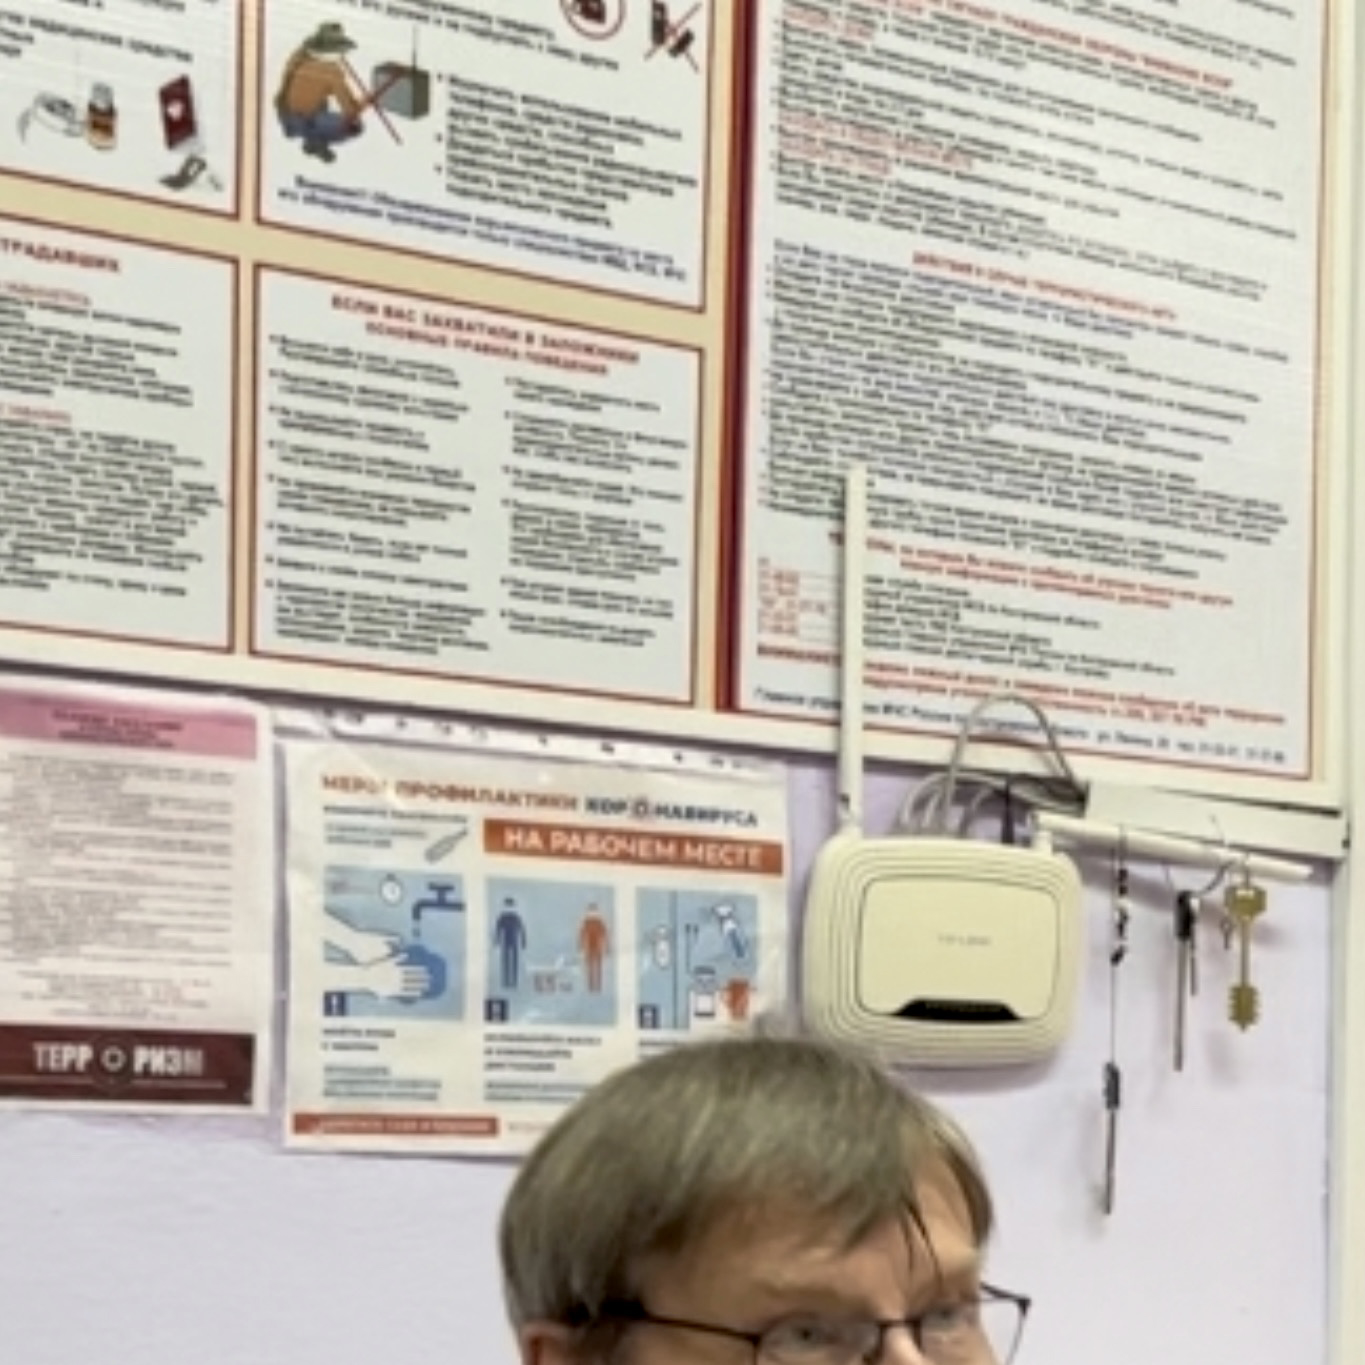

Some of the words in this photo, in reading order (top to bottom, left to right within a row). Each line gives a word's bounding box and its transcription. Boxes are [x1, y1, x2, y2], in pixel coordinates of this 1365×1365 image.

[395, 779, 578, 811] ПРОФИЛАКТИКИ
[503, 827, 545, 851] НА
[549, 830, 675, 864] РАБОЧЕМ
[685, 841, 762, 869] МЕСТЕ
